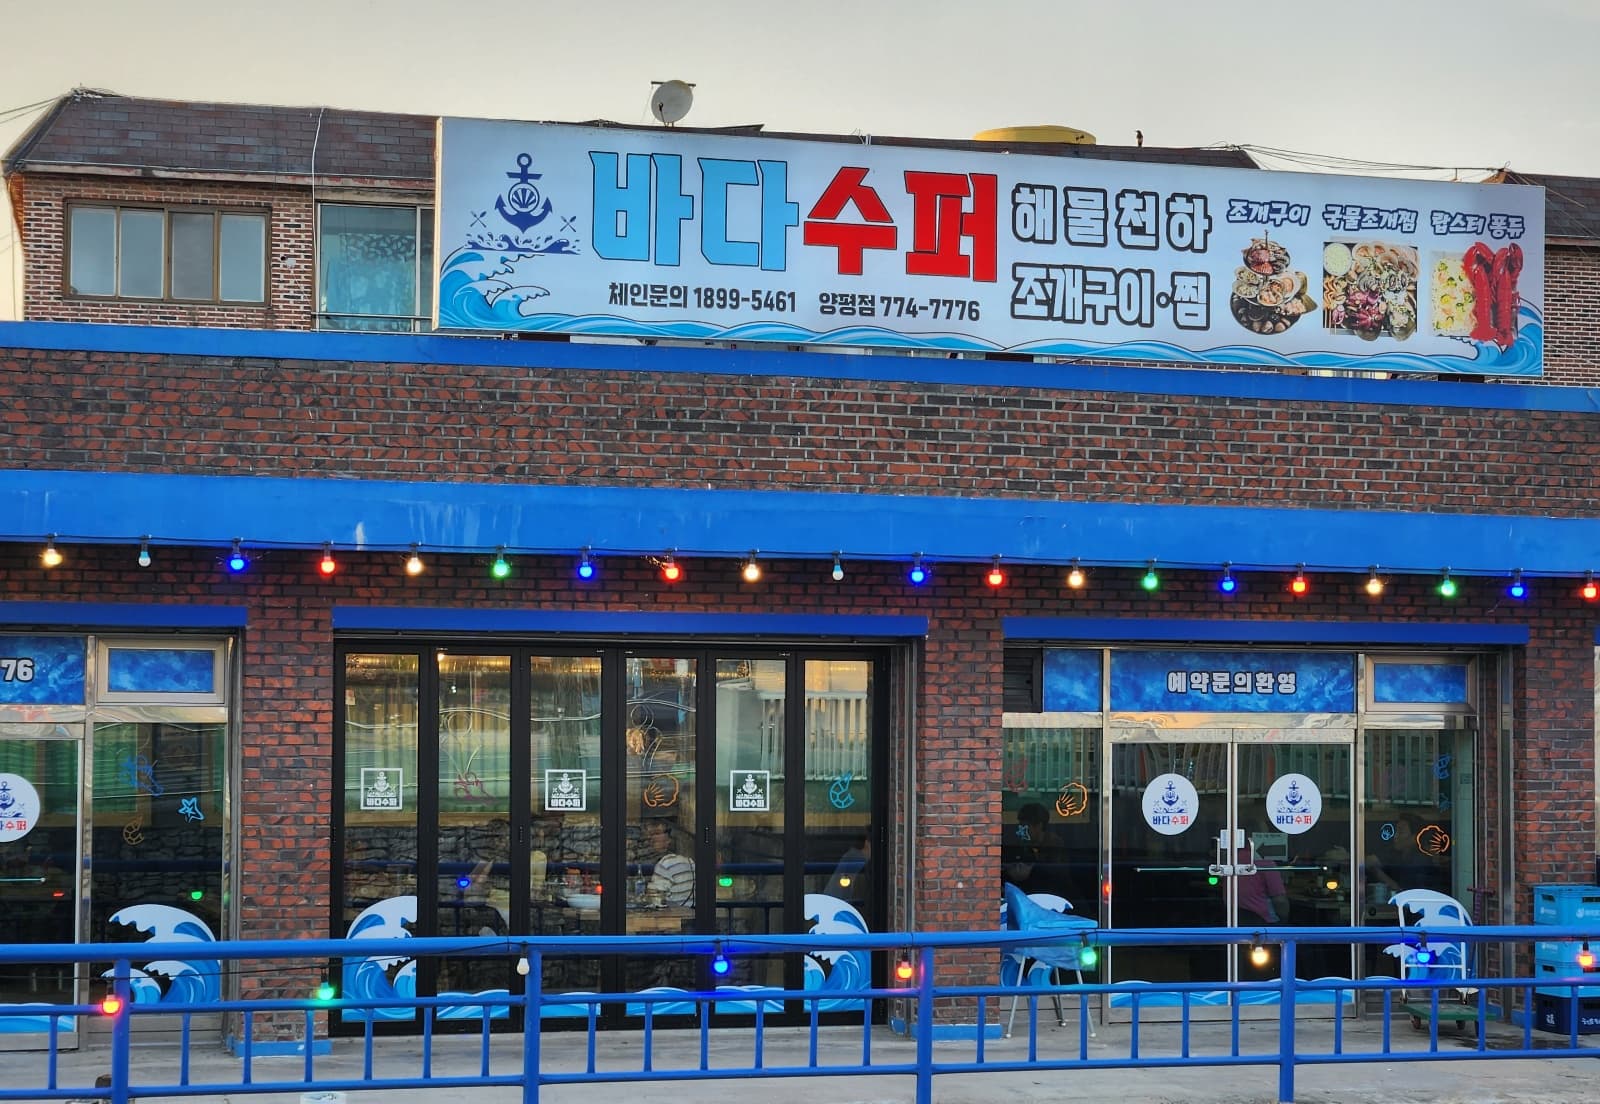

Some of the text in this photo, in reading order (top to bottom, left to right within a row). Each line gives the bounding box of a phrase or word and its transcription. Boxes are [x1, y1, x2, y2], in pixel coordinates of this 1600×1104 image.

[588, 150, 998, 283] 바다수퍼
[1011, 182, 1212, 253] 해물천하
[1226, 198, 1312, 227] 조개구이
[1322, 203, 1418, 233] 국물조개찜
[1431, 209, 1525, 239] 랍스터 퐁듀
[608, 282, 797, 313] 체인문의 1899-5461
[818, 292, 981, 322] 양평점 774-7776
[1167, 670, 1298, 695] 예약문의환영
[1152, 815, 1189, 825] 바다수퍼
[1276, 815, 1312, 825] 바다수퍼
